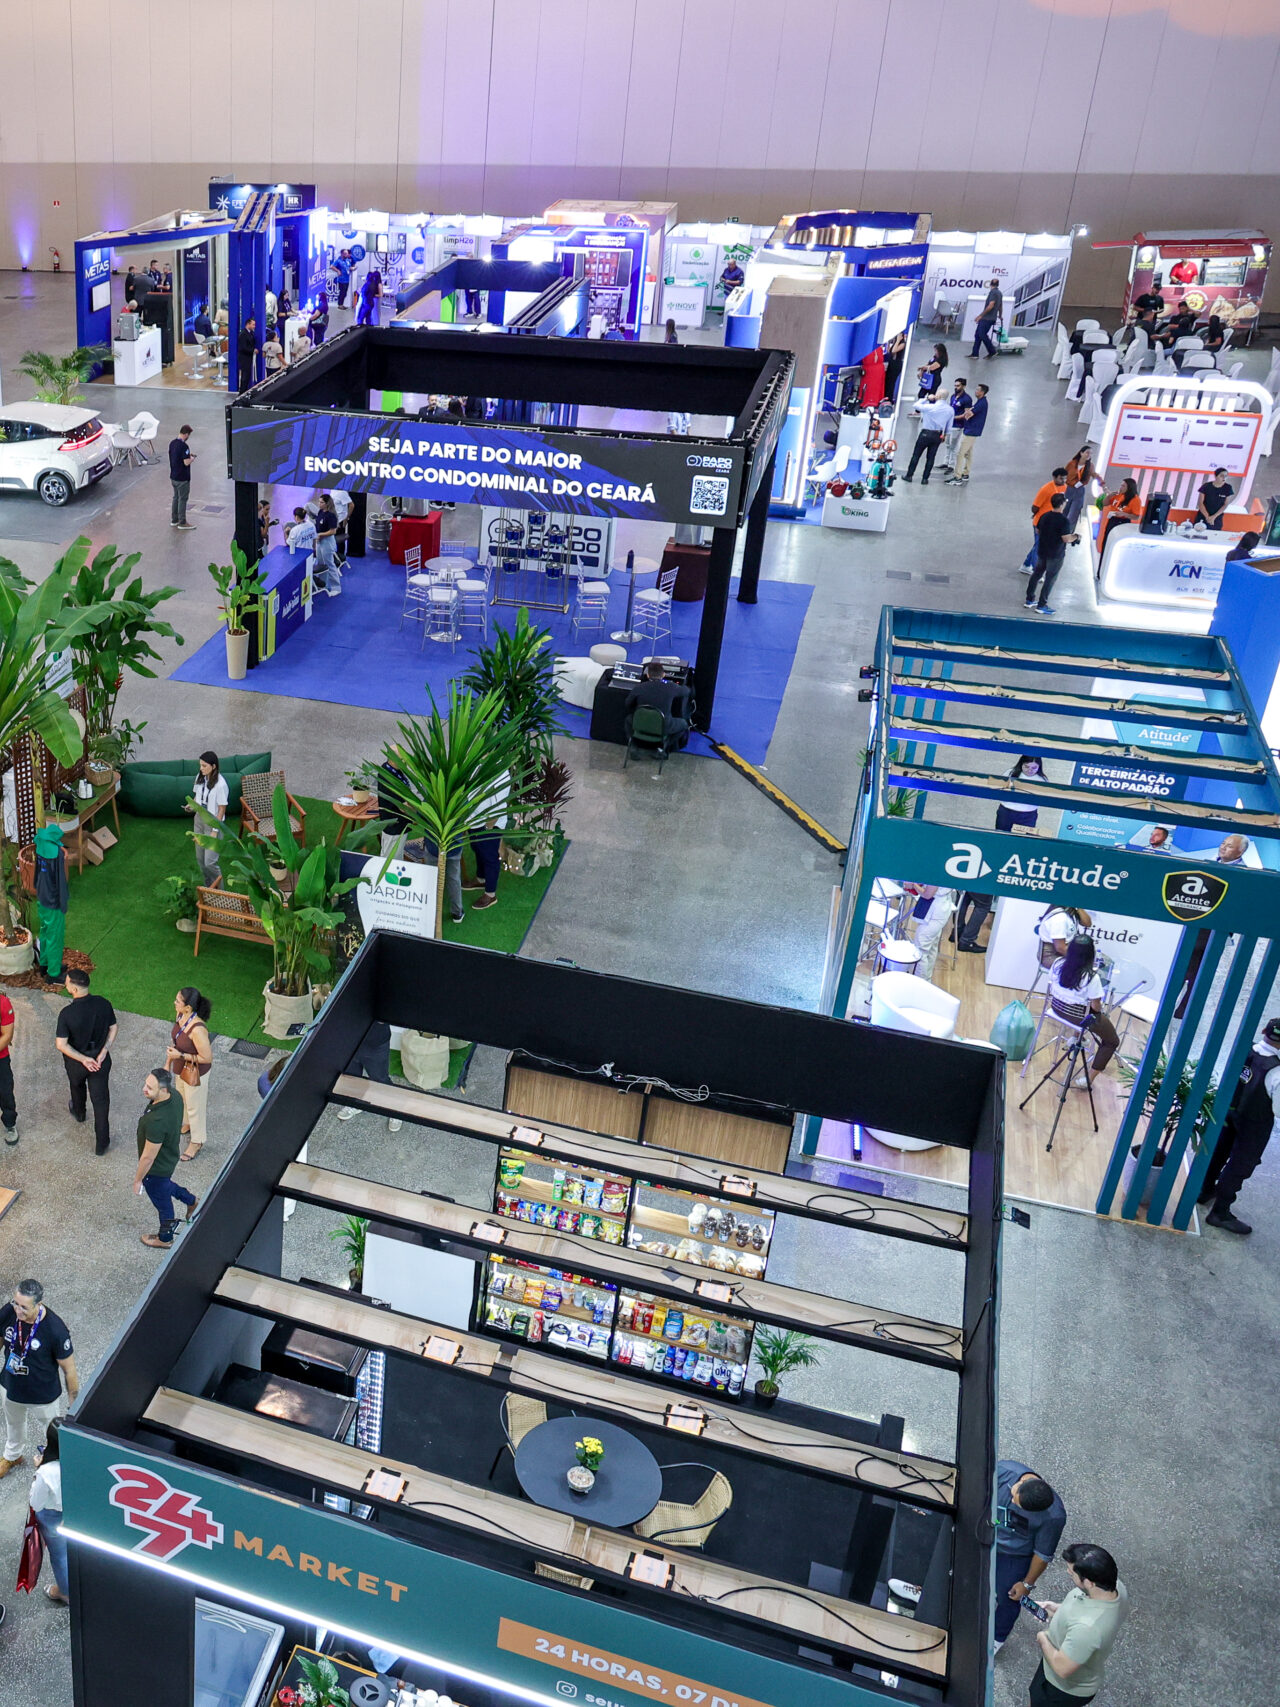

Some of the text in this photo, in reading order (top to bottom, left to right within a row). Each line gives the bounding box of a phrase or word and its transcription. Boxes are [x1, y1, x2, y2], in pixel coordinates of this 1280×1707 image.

[84, 259, 110, 279] METAS
[369, 436, 583, 470] SEJA PARTE DO MAIOR
[702, 456, 733, 465] PAPO
[702, 461, 732, 469] CONDO
[304, 456, 656, 504] ENCONTRO CONDOMINIAL DO CEARÁ
[1080, 765, 1176, 785] TERCEIRIZAÇÃO
[1079, 777, 1171, 796] DE ALTO PADRÃO
[996, 874, 1055, 892] SERVIÇOS
[366, 884, 428, 905] JARDINI
[1171, 894, 1211, 907] Atente
[1076, 923, 1139, 945] titude
[234, 1530, 408, 1602] MARKET
[534, 1638, 566, 1659] 24
[571, 1650, 670, 1695] HORAS,
[675, 1684, 707, 1704] 07
